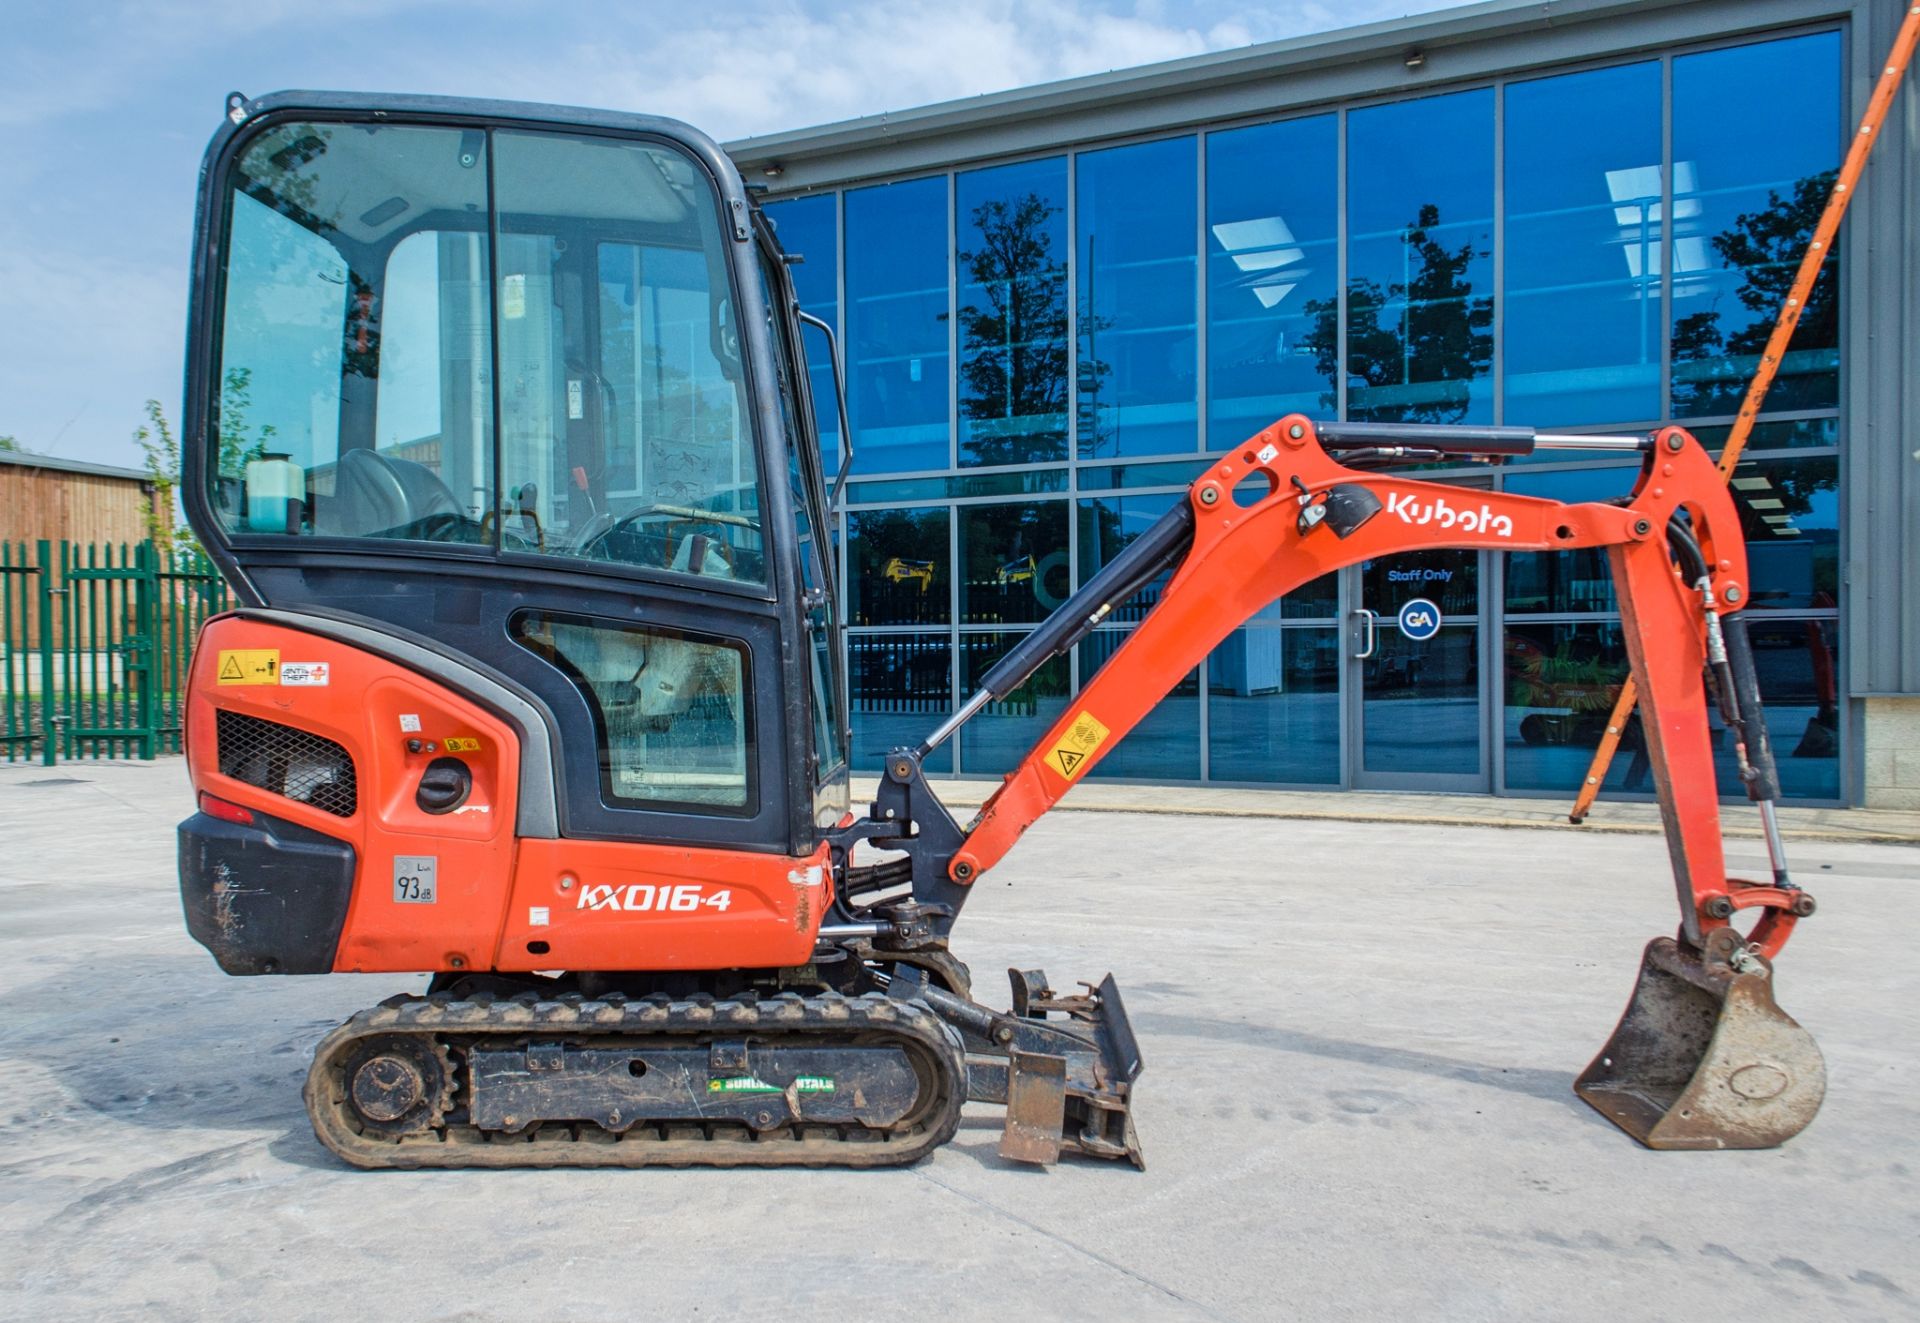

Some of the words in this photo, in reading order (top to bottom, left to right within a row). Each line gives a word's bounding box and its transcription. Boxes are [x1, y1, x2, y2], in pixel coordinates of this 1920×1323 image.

[1387, 492, 1513, 537] Kubota
[1388, 570, 1421, 581] Staff
[1423, 569, 1453, 583] Only
[398, 876, 420, 899] 93
[420, 888, 432, 900] dB
[577, 884, 731, 911] KX016-4
[796, 1078, 834, 1089] NTALS
